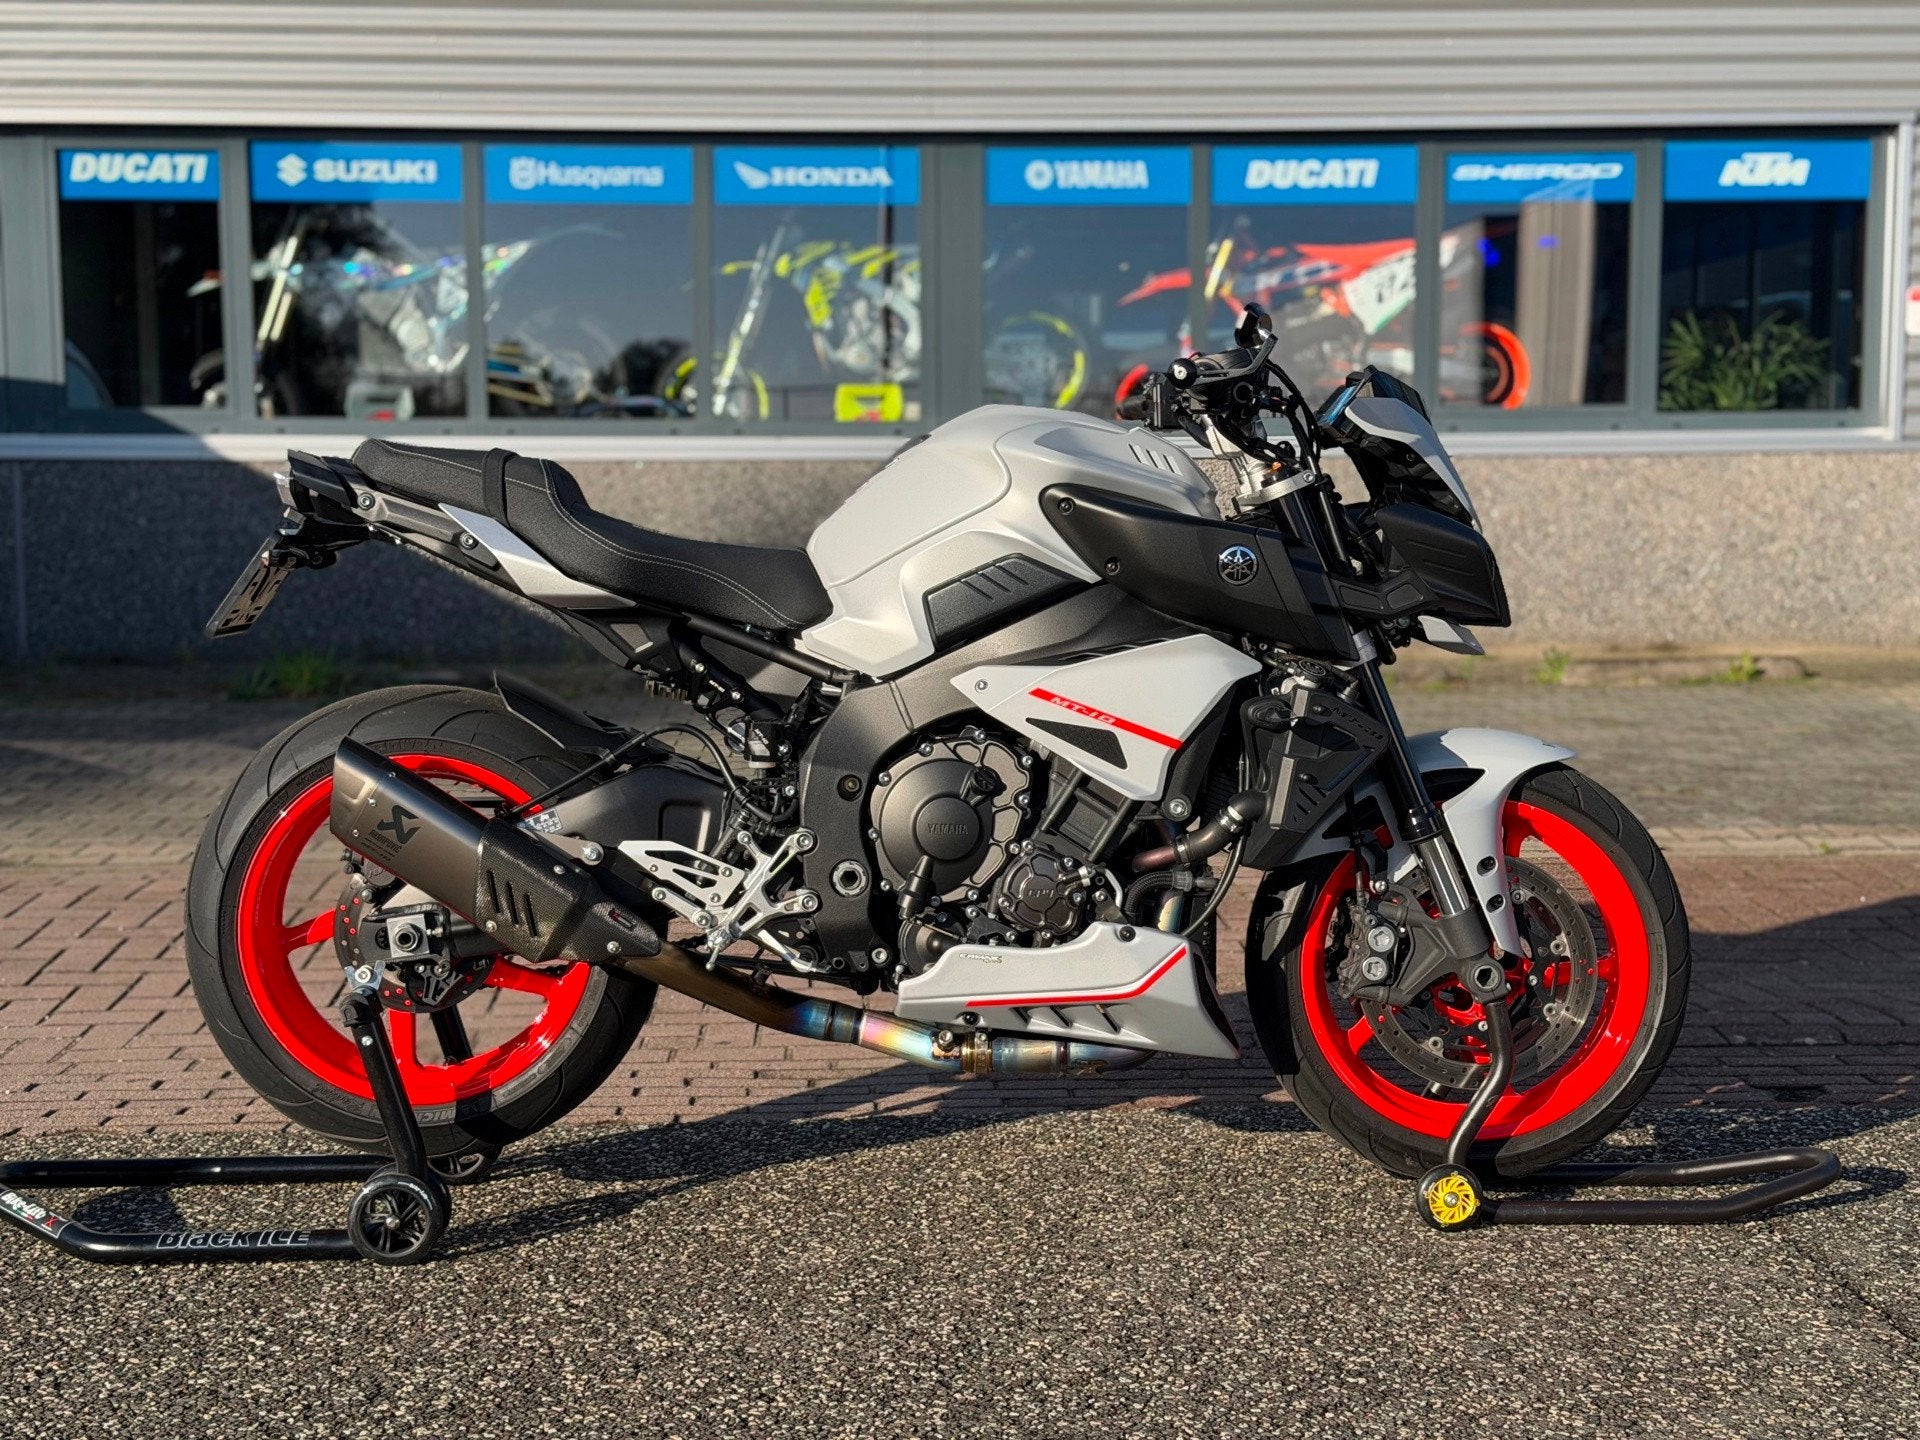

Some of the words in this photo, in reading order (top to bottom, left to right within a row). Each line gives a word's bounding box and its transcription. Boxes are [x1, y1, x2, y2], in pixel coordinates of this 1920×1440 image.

[69, 152, 208, 184] DUCATI
[313, 158, 438, 184] SUZUKI
[769, 166, 894, 187] HONDA
[1054, 160, 1149, 189] YAMAHA
[1244, 158, 1379, 189] DUCATI
[1452, 162, 1623, 181] SHERCO
[1718, 151, 1811, 187] KTM
[1049, 696, 1117, 725] MT-10
[927, 823, 968, 835] YAMAHA
[256, 1230, 311, 1247] ICE
